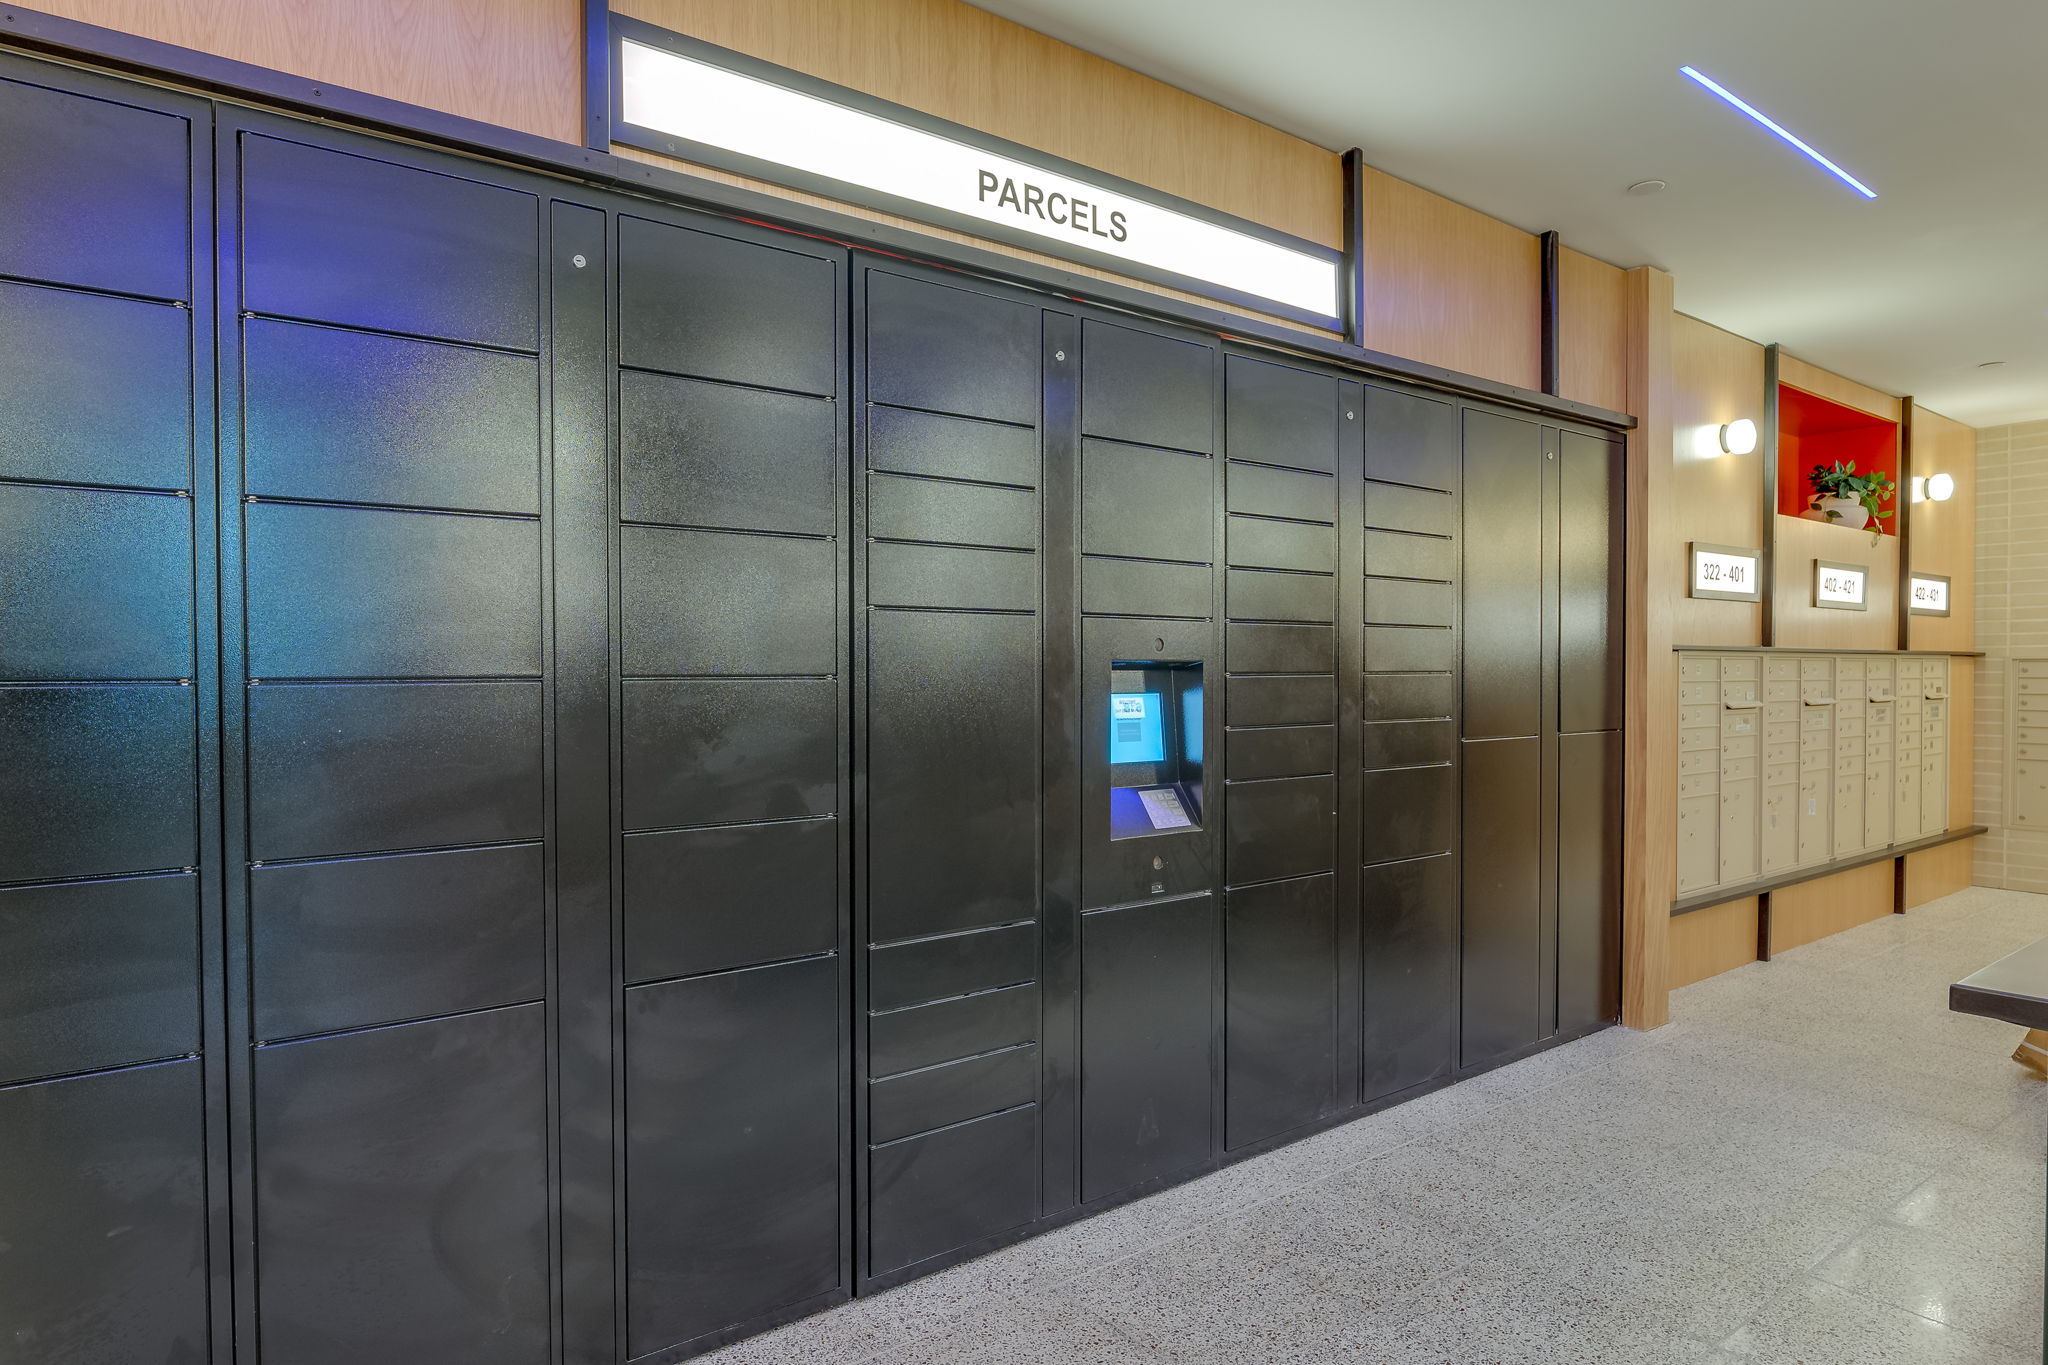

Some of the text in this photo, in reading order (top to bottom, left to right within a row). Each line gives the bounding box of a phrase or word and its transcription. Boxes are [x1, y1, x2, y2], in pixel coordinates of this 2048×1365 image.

[979, 168, 1128, 243] PARCELS
[1704, 563, 1721, 580] 322
[1729, 565, 1745, 583] 401
[1824, 577, 1837, 592] 402
[1843, 579, 1855, 594] 421
[1915, 587, 1926, 600] 422
